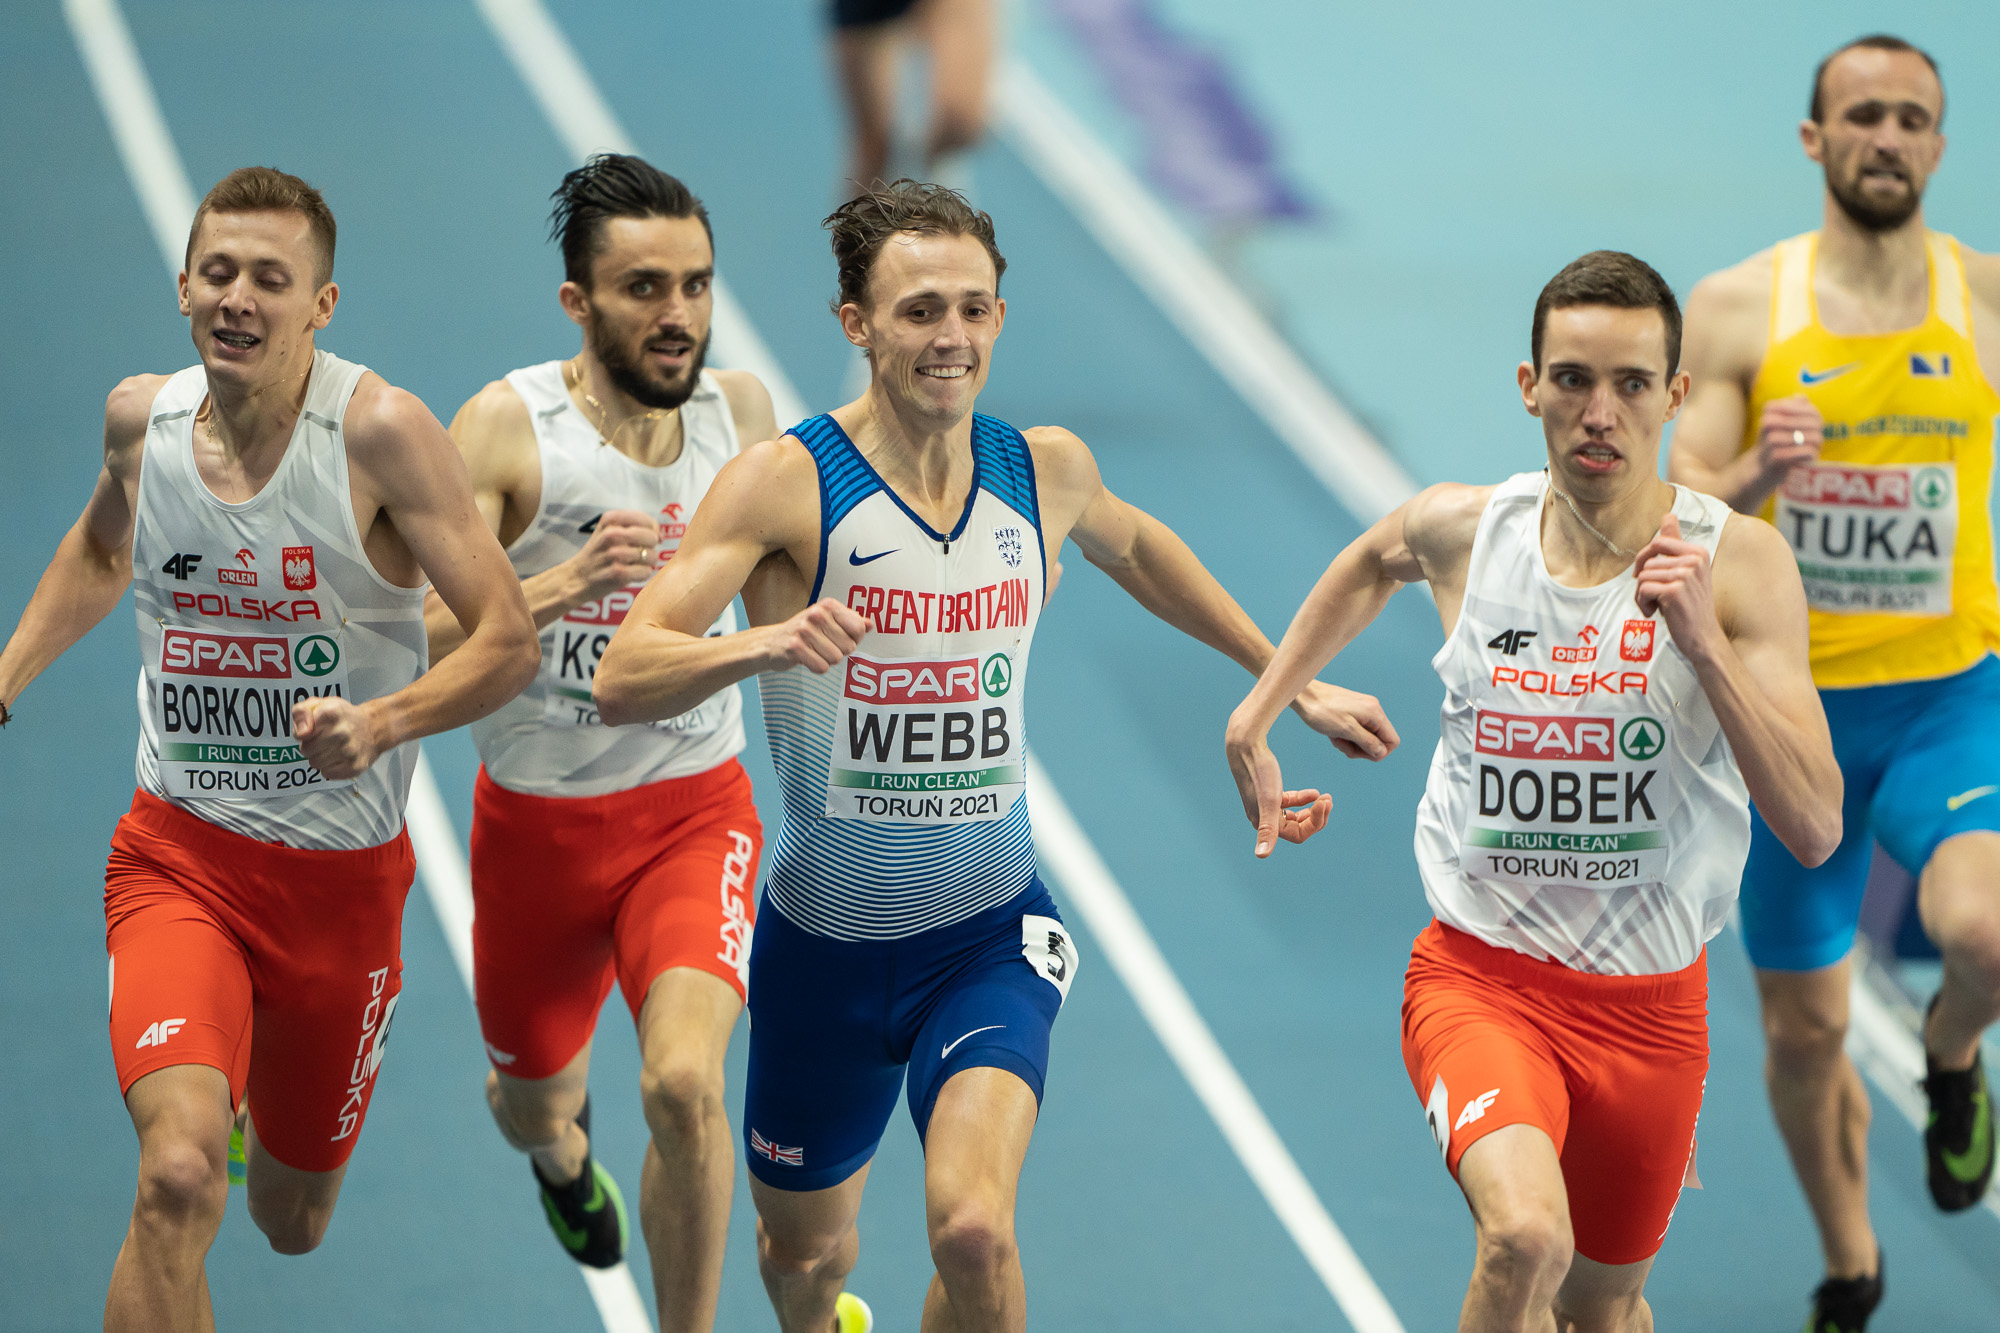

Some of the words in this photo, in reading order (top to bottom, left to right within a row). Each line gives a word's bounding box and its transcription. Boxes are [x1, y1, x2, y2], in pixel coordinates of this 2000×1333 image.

[1786, 468, 1907, 505] SPAR
[1786, 507, 1941, 561] TUKA
[162, 552, 203, 581] 4F
[220, 570, 256, 585] ORLEN
[172, 591, 322, 622] POLSKA
[847, 584, 936, 634] GREAT
[937, 578, 1029, 634] BRITAIN
[165, 637, 288, 673] SPAR
[1487, 629, 1538, 656] 4F
[848, 664, 976, 699] SPAR
[1492, 666, 1648, 697] POLSKA
[848, 706, 1011, 763] WEBB
[1478, 715, 1611, 756] SPAR
[198, 746, 203, 760] I
[207, 746, 244, 762] RUN
[184, 768, 270, 791] TORUŃ
[275, 767, 331, 791] 202
[870, 774, 876, 787] I
[881, 775, 920, 789] RUN
[1478, 764, 1658, 825] DOBEK
[854, 795, 943, 818] TORUŃ
[949, 793, 998, 817] 2021
[1502, 833, 1507, 847] I
[1511, 834, 1552, 849] RUN
[1487, 855, 1579, 879] TORUŃ
[1585, 858, 1640, 881] 2021
[716, 829, 754, 977] POLSKA
[135, 1018, 187, 1050] 4F
[330, 966, 389, 1142] POLSKA
[1454, 1088, 1501, 1132] 4F
